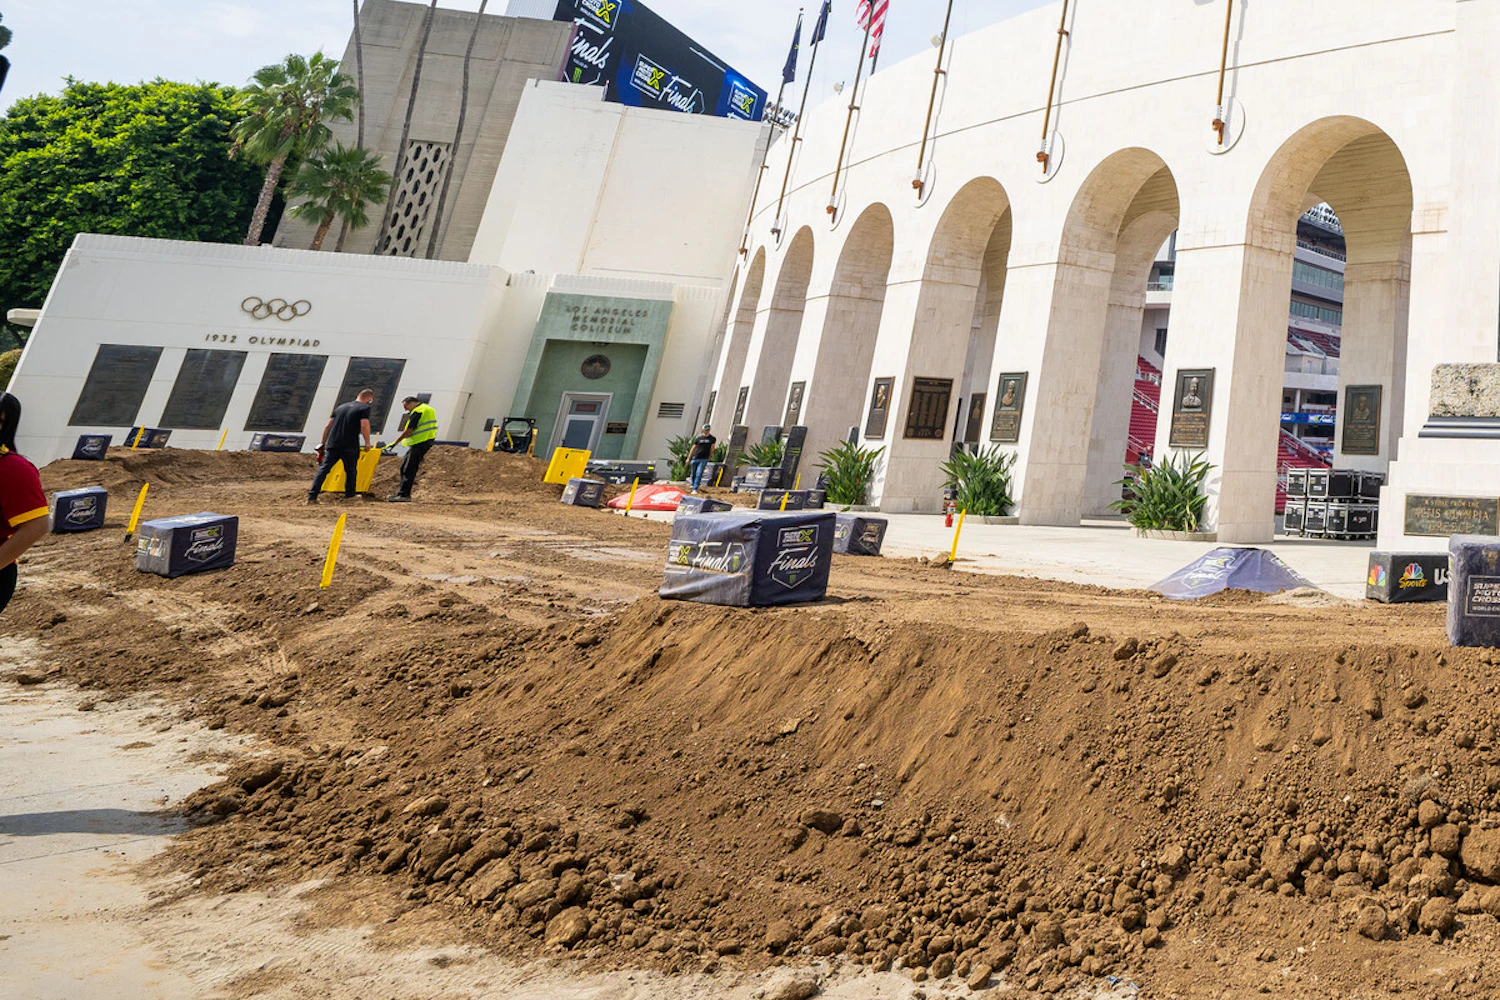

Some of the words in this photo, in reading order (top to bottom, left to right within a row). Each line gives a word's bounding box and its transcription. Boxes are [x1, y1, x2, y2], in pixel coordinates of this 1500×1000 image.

[658, 75, 699, 114] Finals
[594, 308, 648, 318] ANGELES
[572, 315, 635, 326] MEMORIAL
[571, 324, 631, 334] COLISEUM
[205, 334, 237, 344] 1932
[248, 336, 320, 347] OLYMPIAD
[1445, 510, 1490, 521] OLYMPIA
[1429, 521, 1472, 533] GREECE
[185, 538, 224, 558] Finals
[690, 541, 733, 574] Finals
[768, 546, 819, 574] Finals
[1398, 577, 1428, 590] Sports
